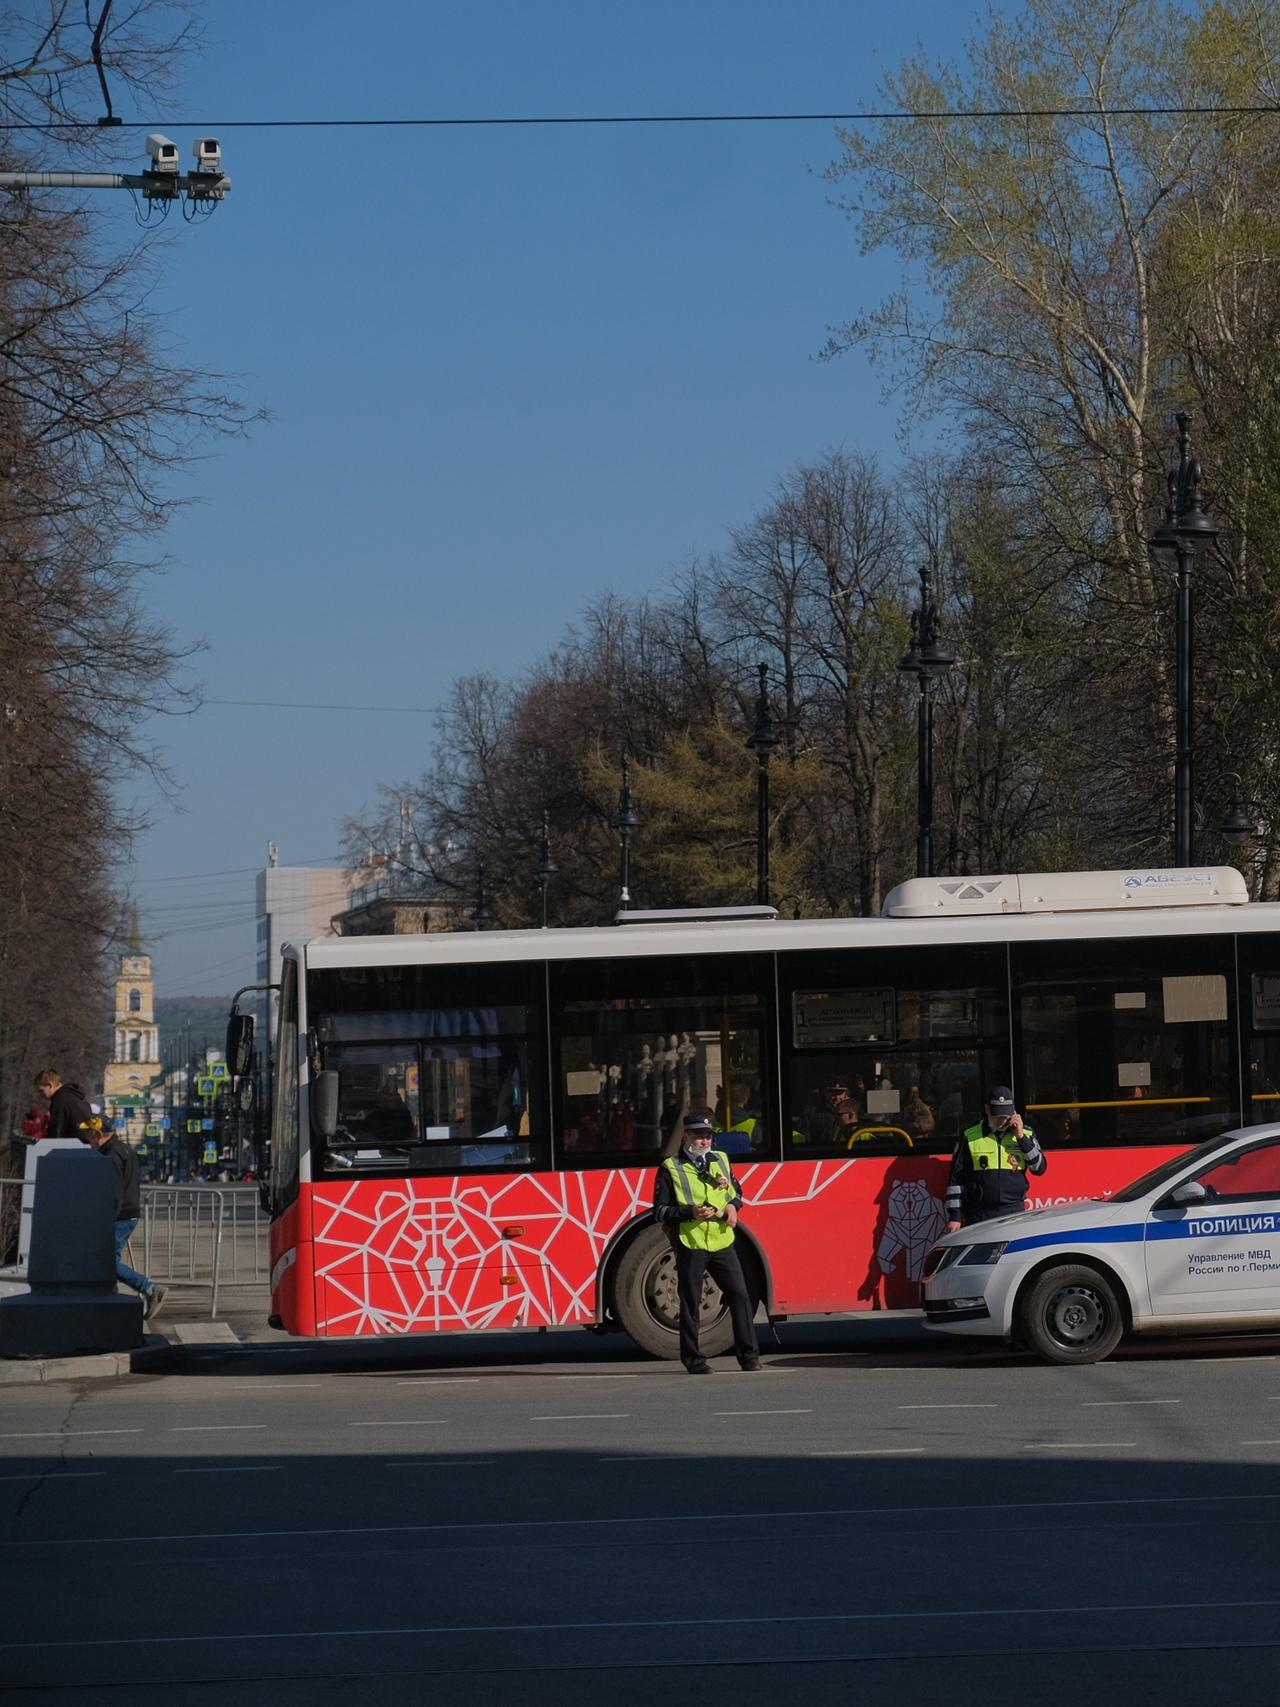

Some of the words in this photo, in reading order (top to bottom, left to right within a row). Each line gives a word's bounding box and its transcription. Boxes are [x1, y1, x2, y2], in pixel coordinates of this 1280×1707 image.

[1188, 1216, 1275, 1235] ПОЛИЦИЯ
[1188, 1252, 1245, 1264] Управление
[1248, 1250, 1271, 1260] МВД
[1188, 1266, 1224, 1275] России
